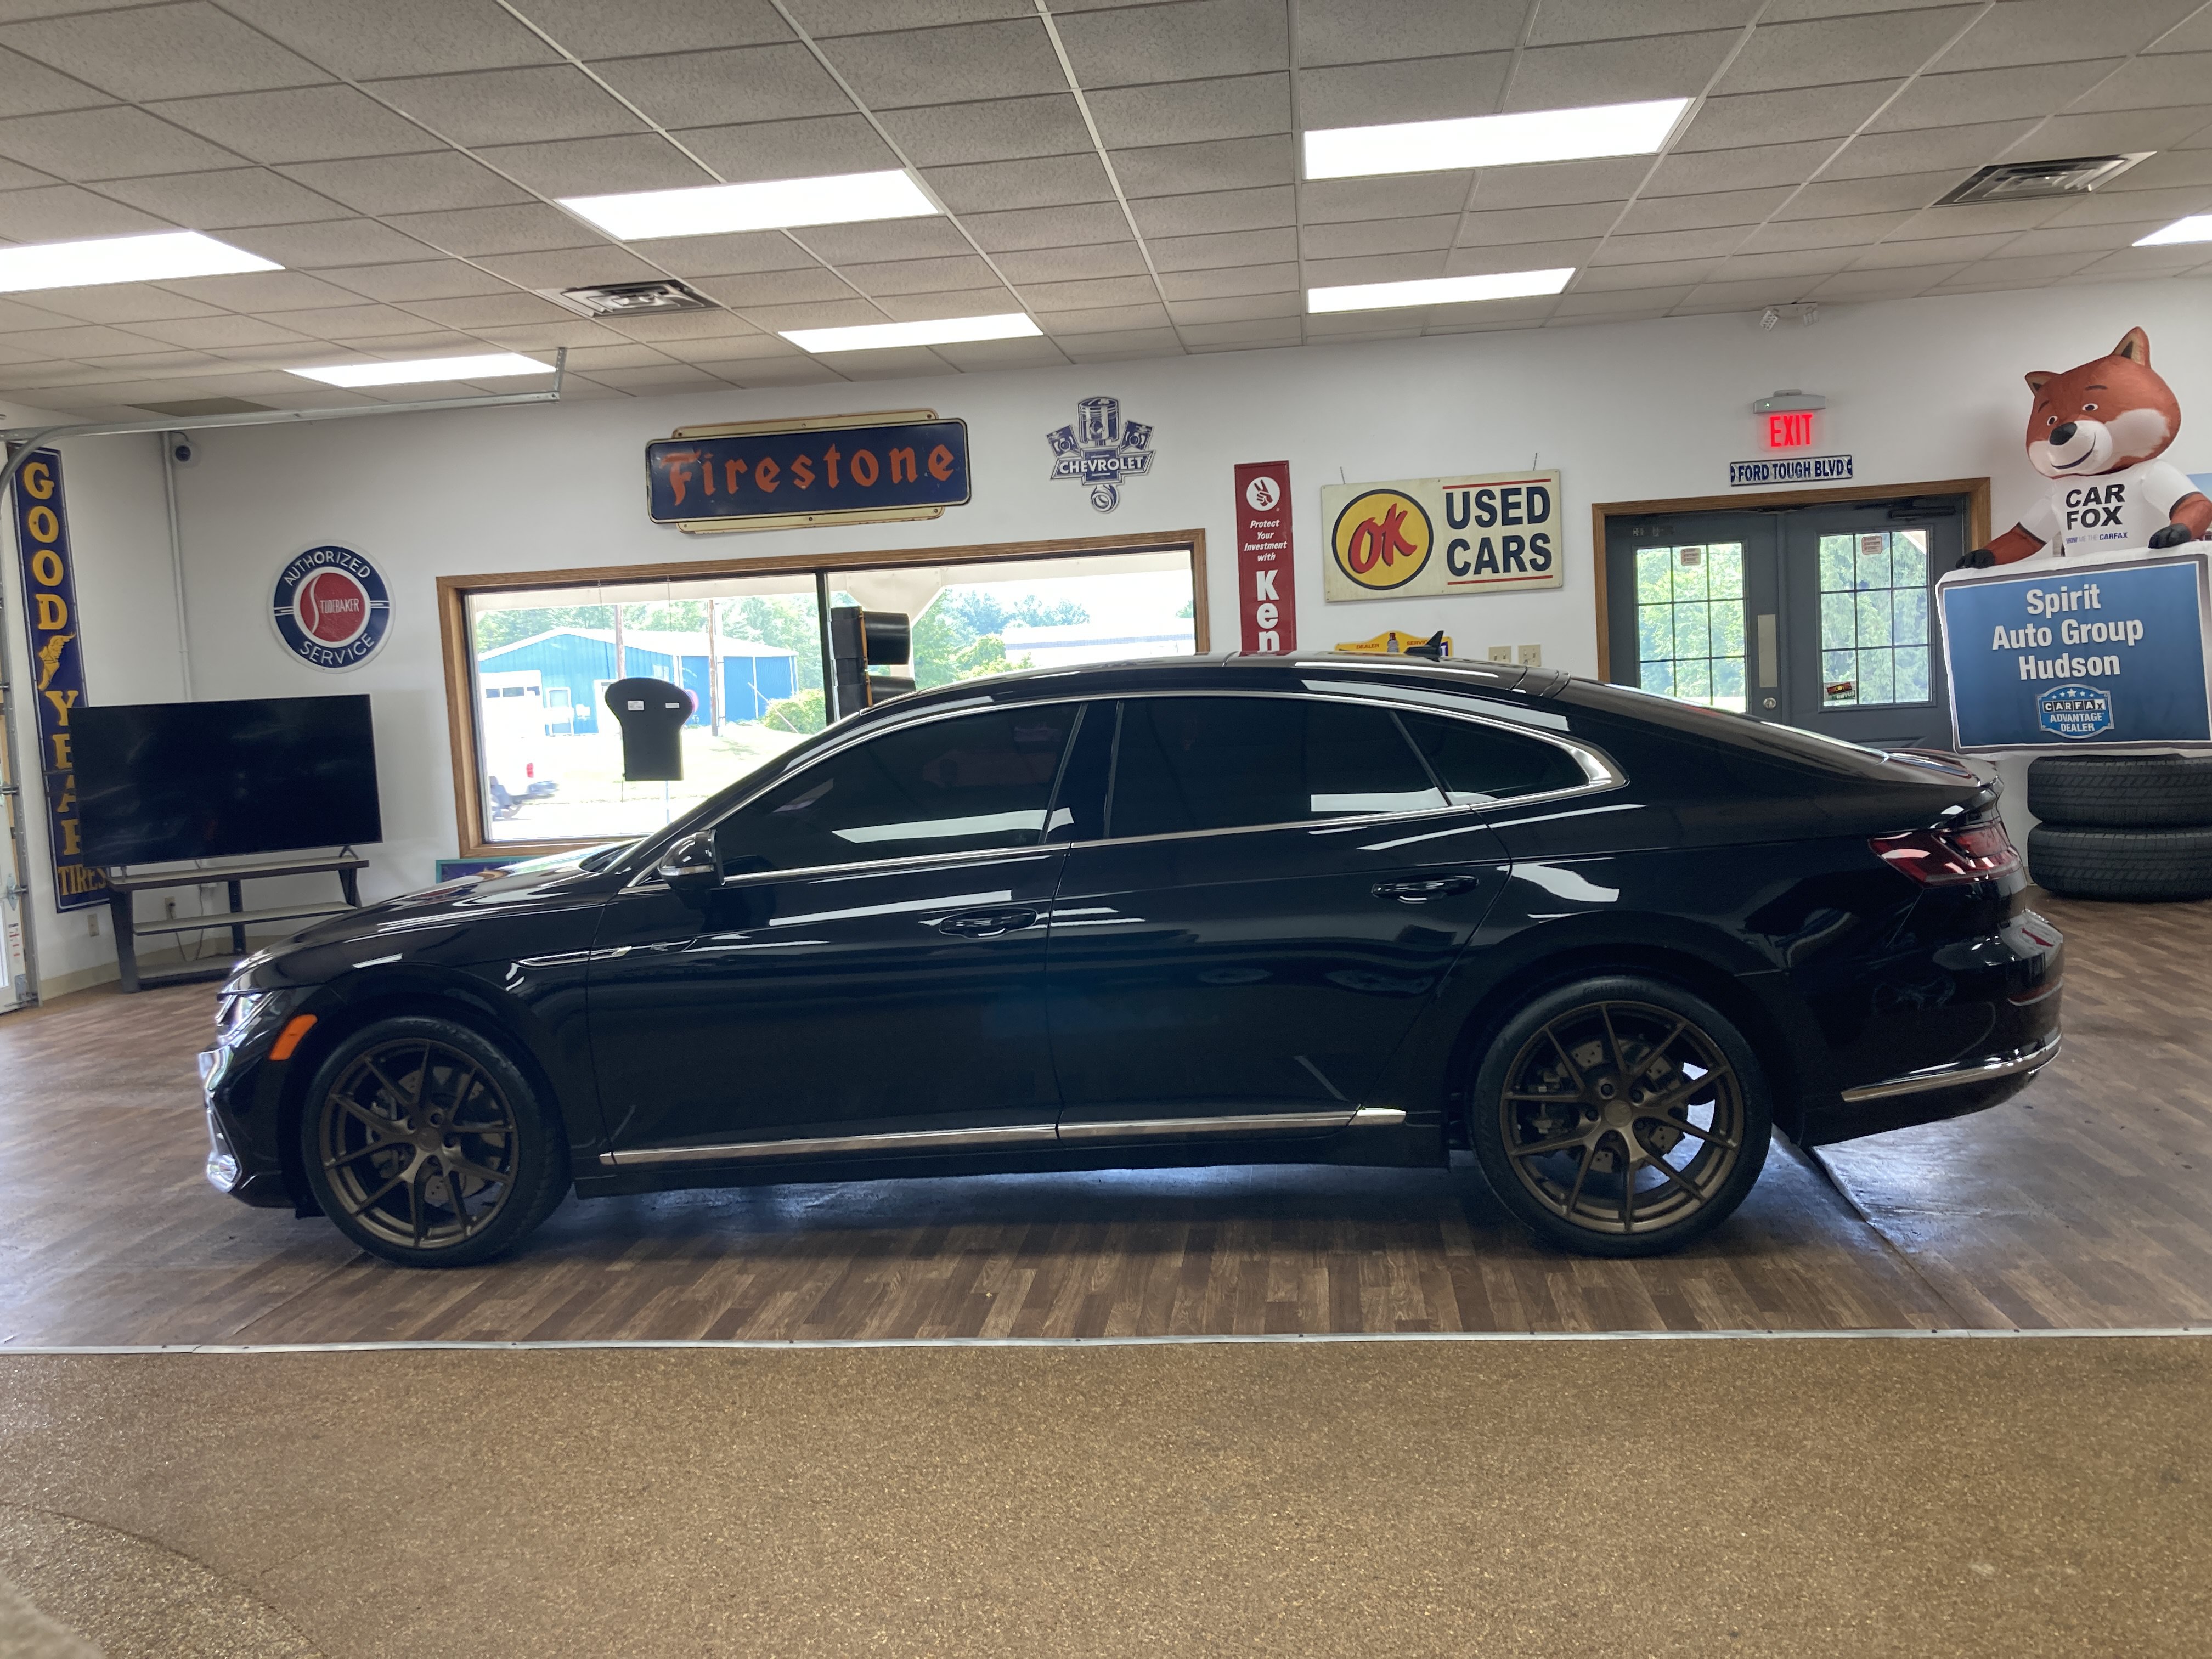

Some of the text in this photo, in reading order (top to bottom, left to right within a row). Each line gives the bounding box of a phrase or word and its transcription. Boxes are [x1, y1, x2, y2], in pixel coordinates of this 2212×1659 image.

[1770, 413, 1813, 447] EXIT
[659, 443, 955, 506] Firestone
[1059, 456, 1143, 474] CHEVROLET
[1738, 459, 1844, 482] FORD TOUGH BLVD
[1446, 486, 1551, 529] USED
[2066, 483, 2125, 508] CAR
[1250, 519, 1280, 529] Protect
[2066, 506, 2124, 531] FOX
[1244, 541, 1288, 551] Investment
[1257, 532, 1274, 540] Your
[1348, 503, 1418, 574] OK
[1257, 552, 1276, 562] with
[1446, 533, 1553, 577] CARS
[284, 551, 371, 586] AUTHORIZED
[2026, 584, 2101, 619] Spirit
[1992, 619, 2143, 651] Auto Group
[300, 633, 375, 665] SERVICE
[2019, 653, 2120, 680] Hudson
[2045, 701, 2103, 711] CARFAX
[2050, 713, 2102, 723] ADVANTAGE
[2061, 723, 2095, 732] DEALER
